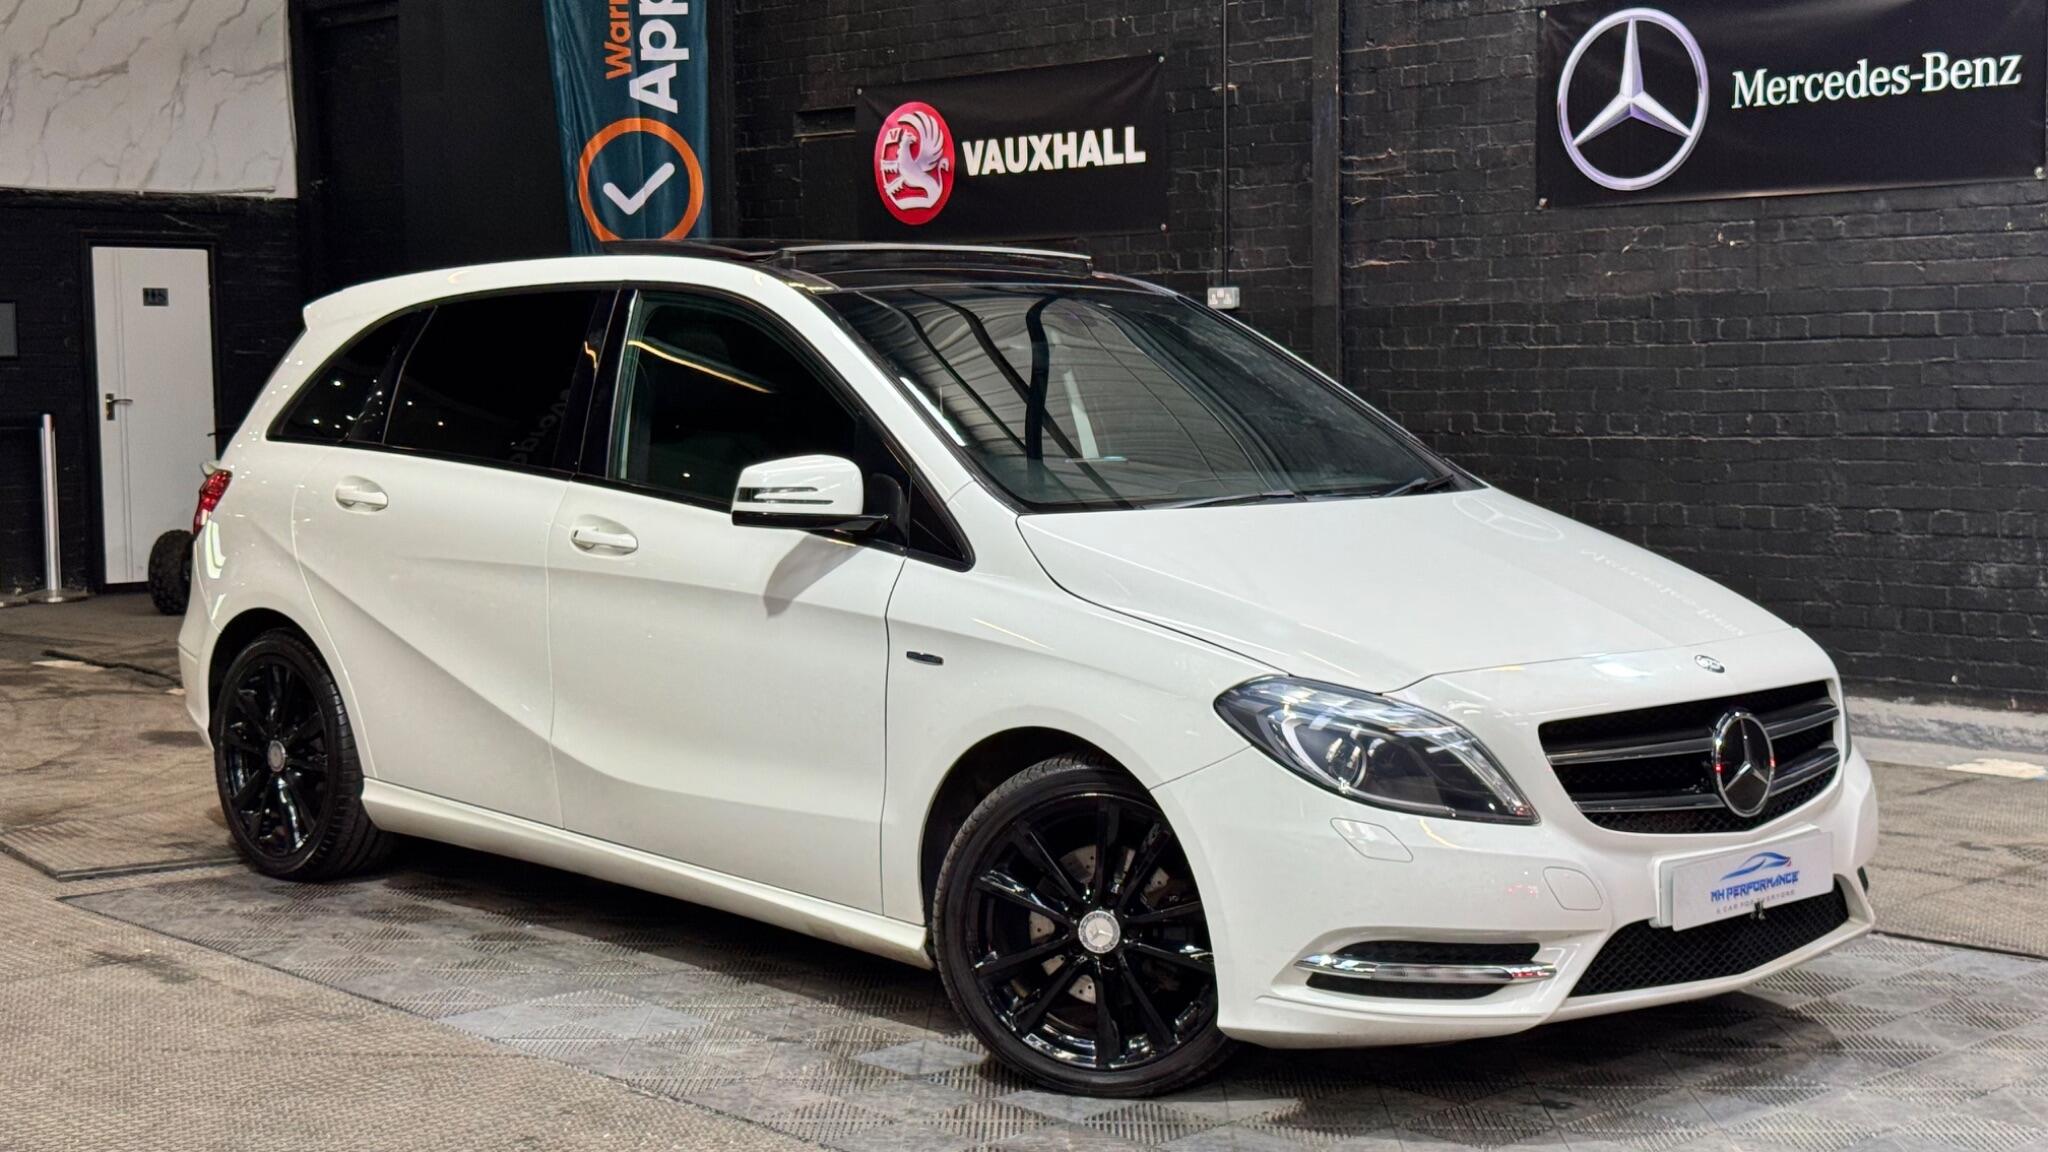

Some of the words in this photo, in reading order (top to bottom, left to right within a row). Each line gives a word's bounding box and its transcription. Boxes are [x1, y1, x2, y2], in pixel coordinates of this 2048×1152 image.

[1731, 51, 2022, 110] Mercedes-Benz
[962, 126, 1146, 177] VAUXHALL
[1726, 871, 1800, 900] PERFORMANCE
